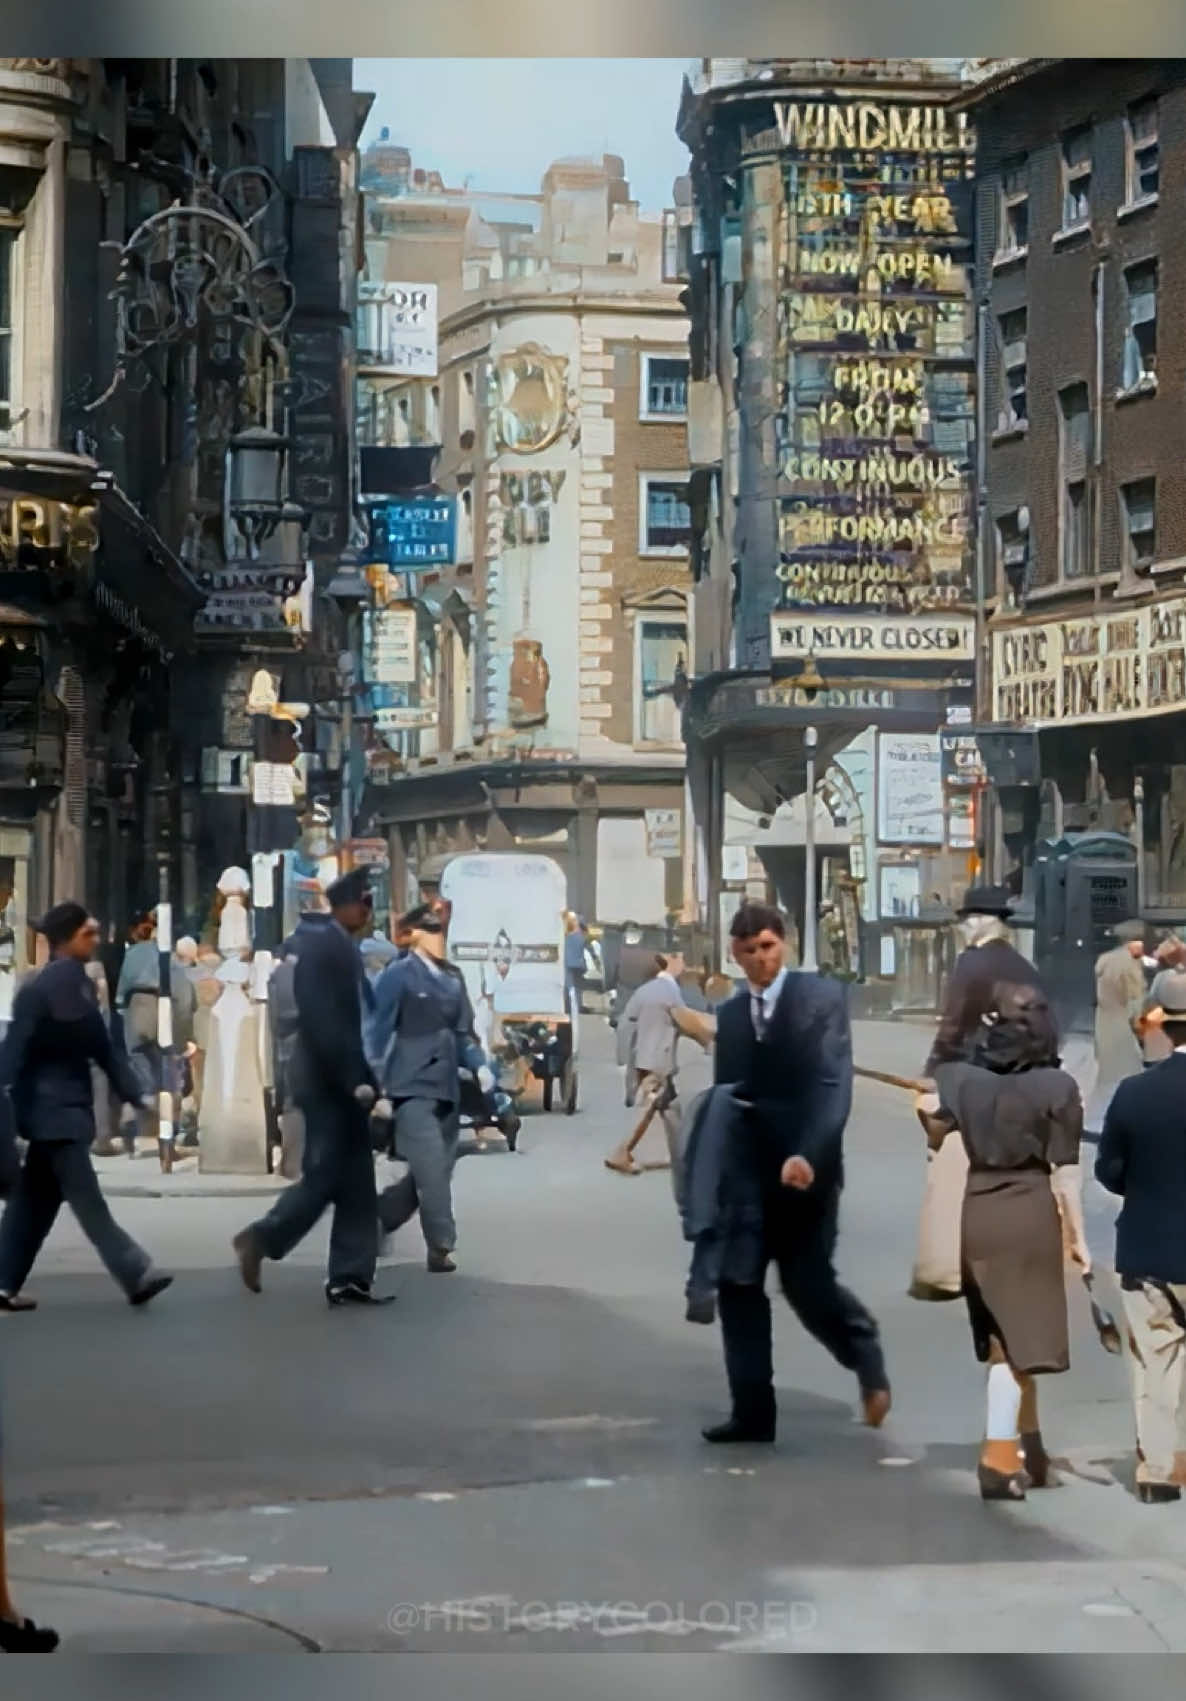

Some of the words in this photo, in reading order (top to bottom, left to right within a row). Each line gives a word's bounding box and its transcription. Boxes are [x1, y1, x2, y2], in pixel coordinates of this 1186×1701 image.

[867, 195, 957, 224] YEAR
[877, 251, 954, 278] OPEN
[783, 454, 965, 487] CONTINUOUS
[812, 624, 876, 649] NEVER
